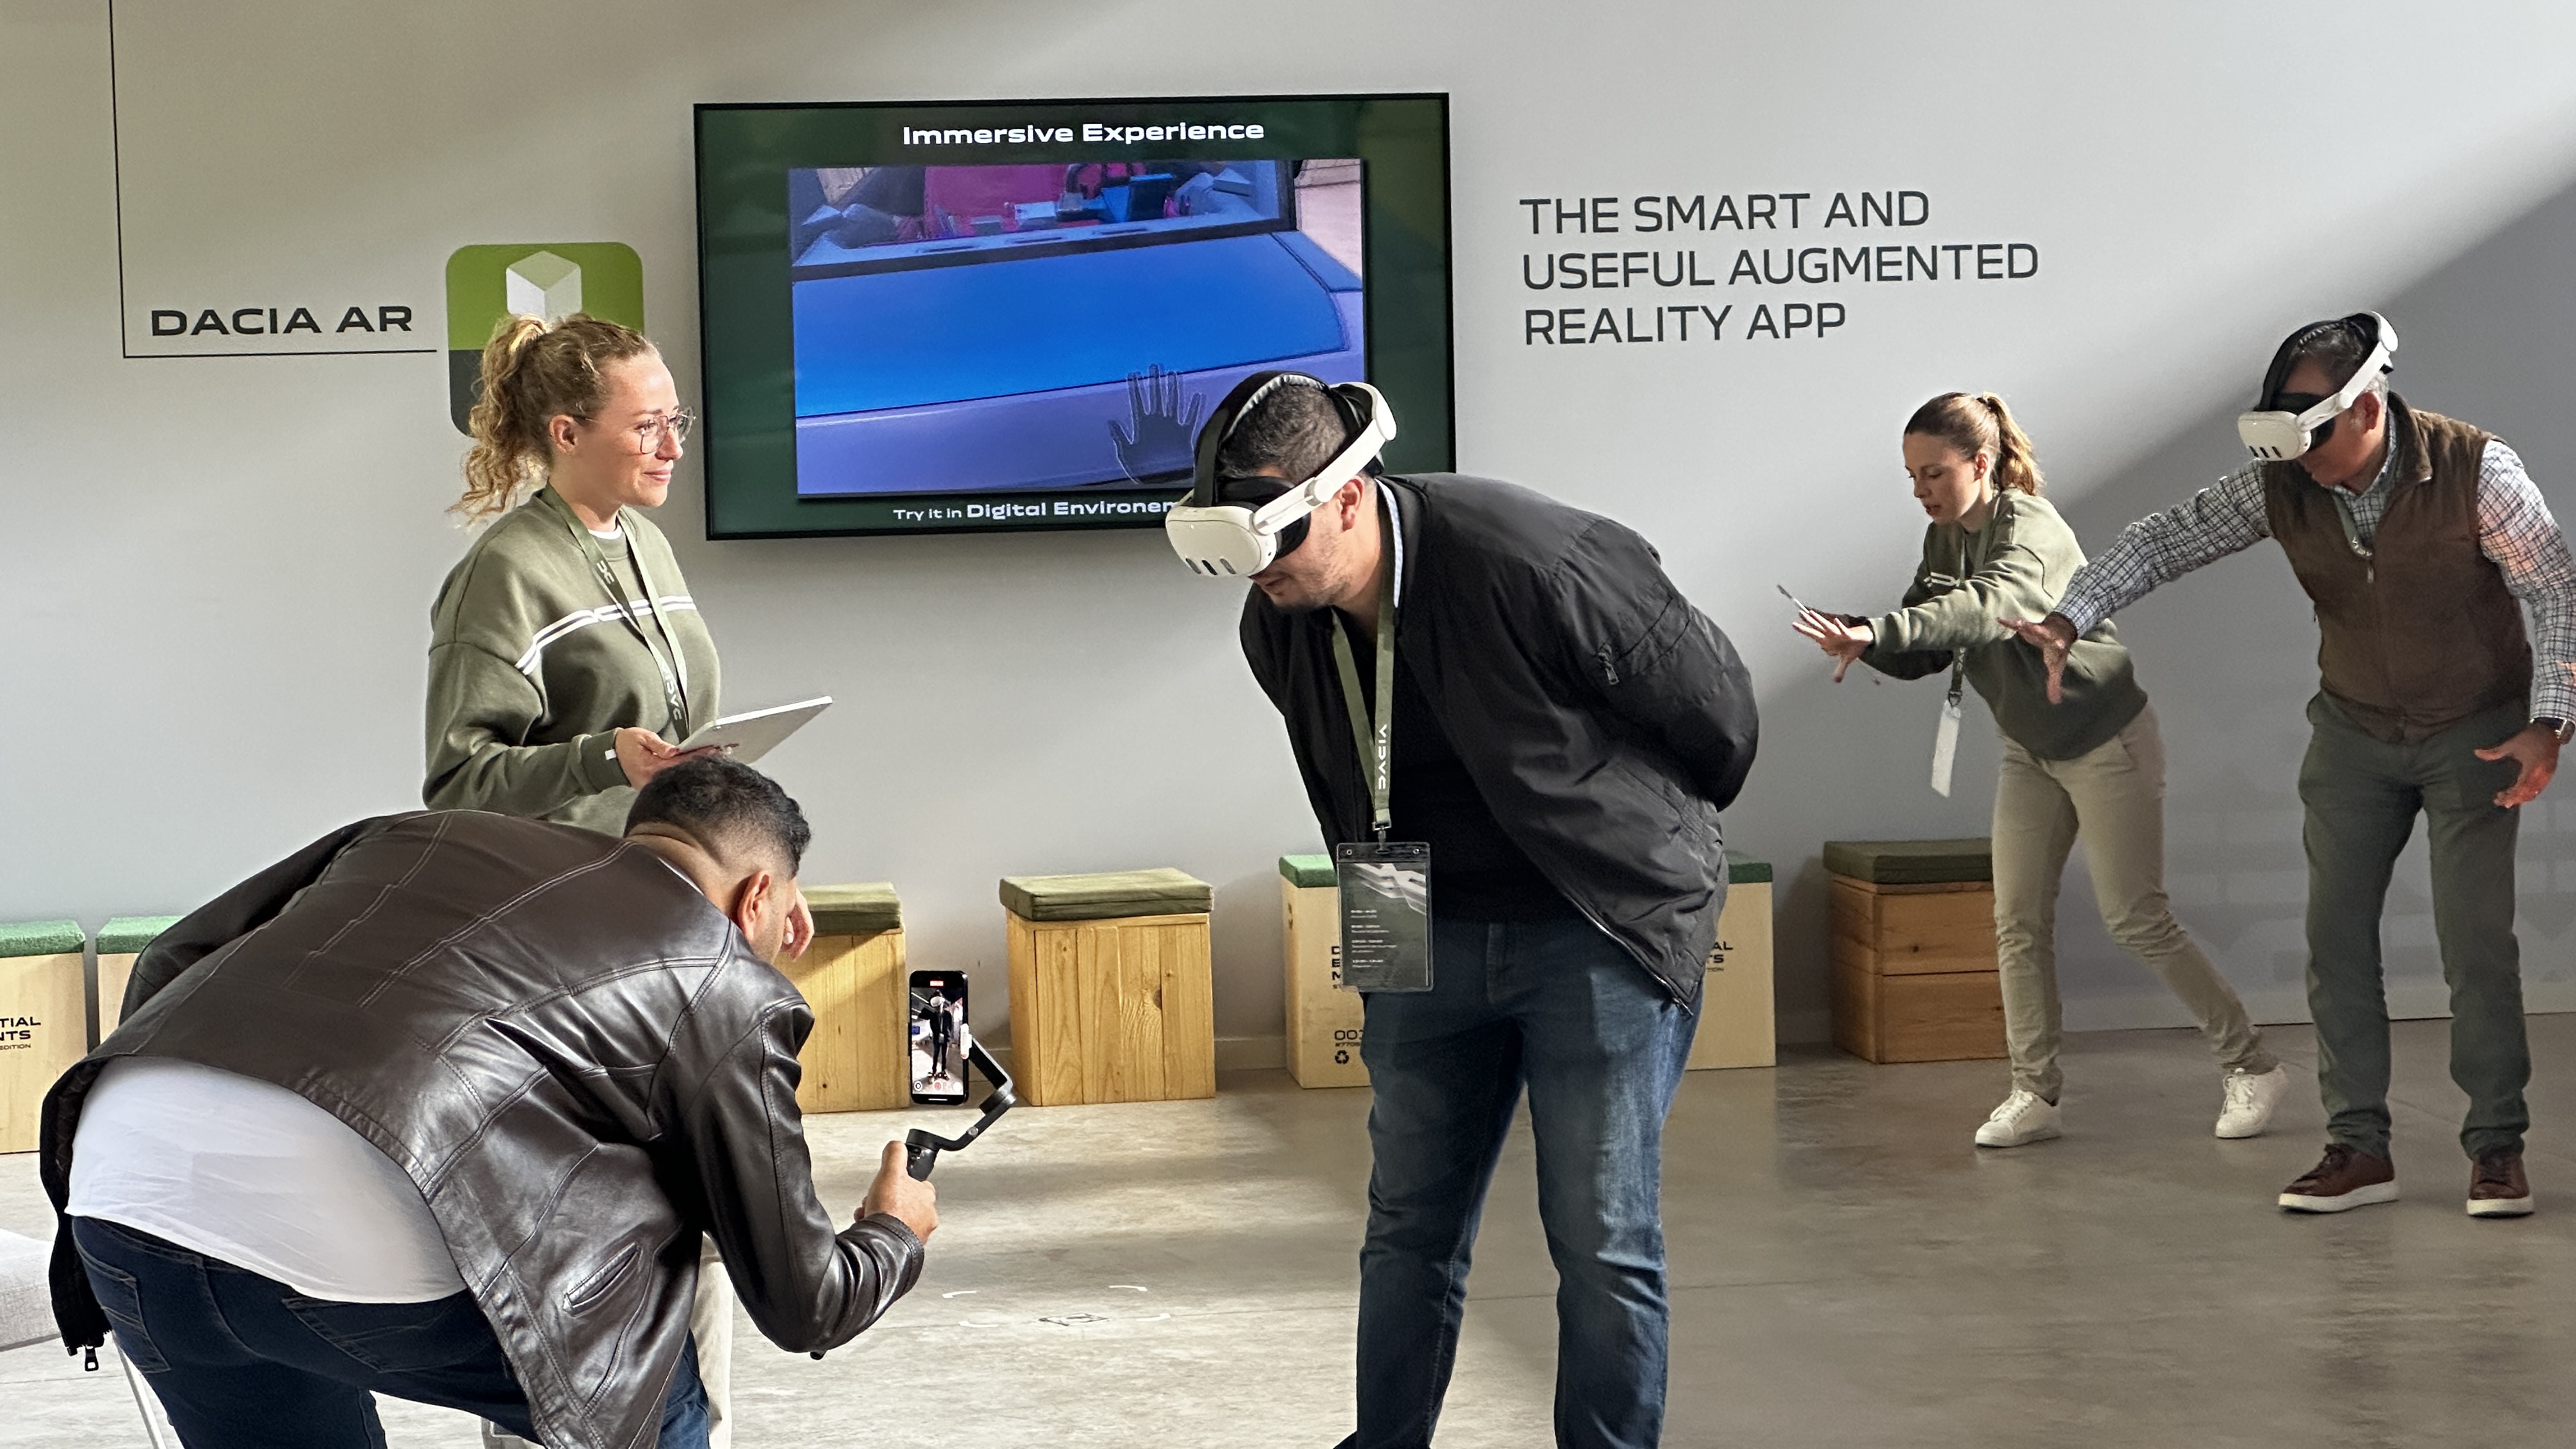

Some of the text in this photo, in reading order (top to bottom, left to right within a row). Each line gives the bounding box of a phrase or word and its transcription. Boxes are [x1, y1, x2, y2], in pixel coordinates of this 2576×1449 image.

[903, 122, 1264, 145] Immersive Experience
[1519, 191, 1929, 234] THE SMART AND
[1523, 243, 2038, 289] USEFUL AUGMENTED
[151, 306, 412, 336] DACIA AR
[1525, 302, 1845, 345] REALITY APP
[893, 509, 924, 521] Try
[928, 508, 943, 519] it
[946, 508, 962, 518] in
[967, 502, 1046, 520] Digital
[1378, 724, 1387, 790] DACIA
